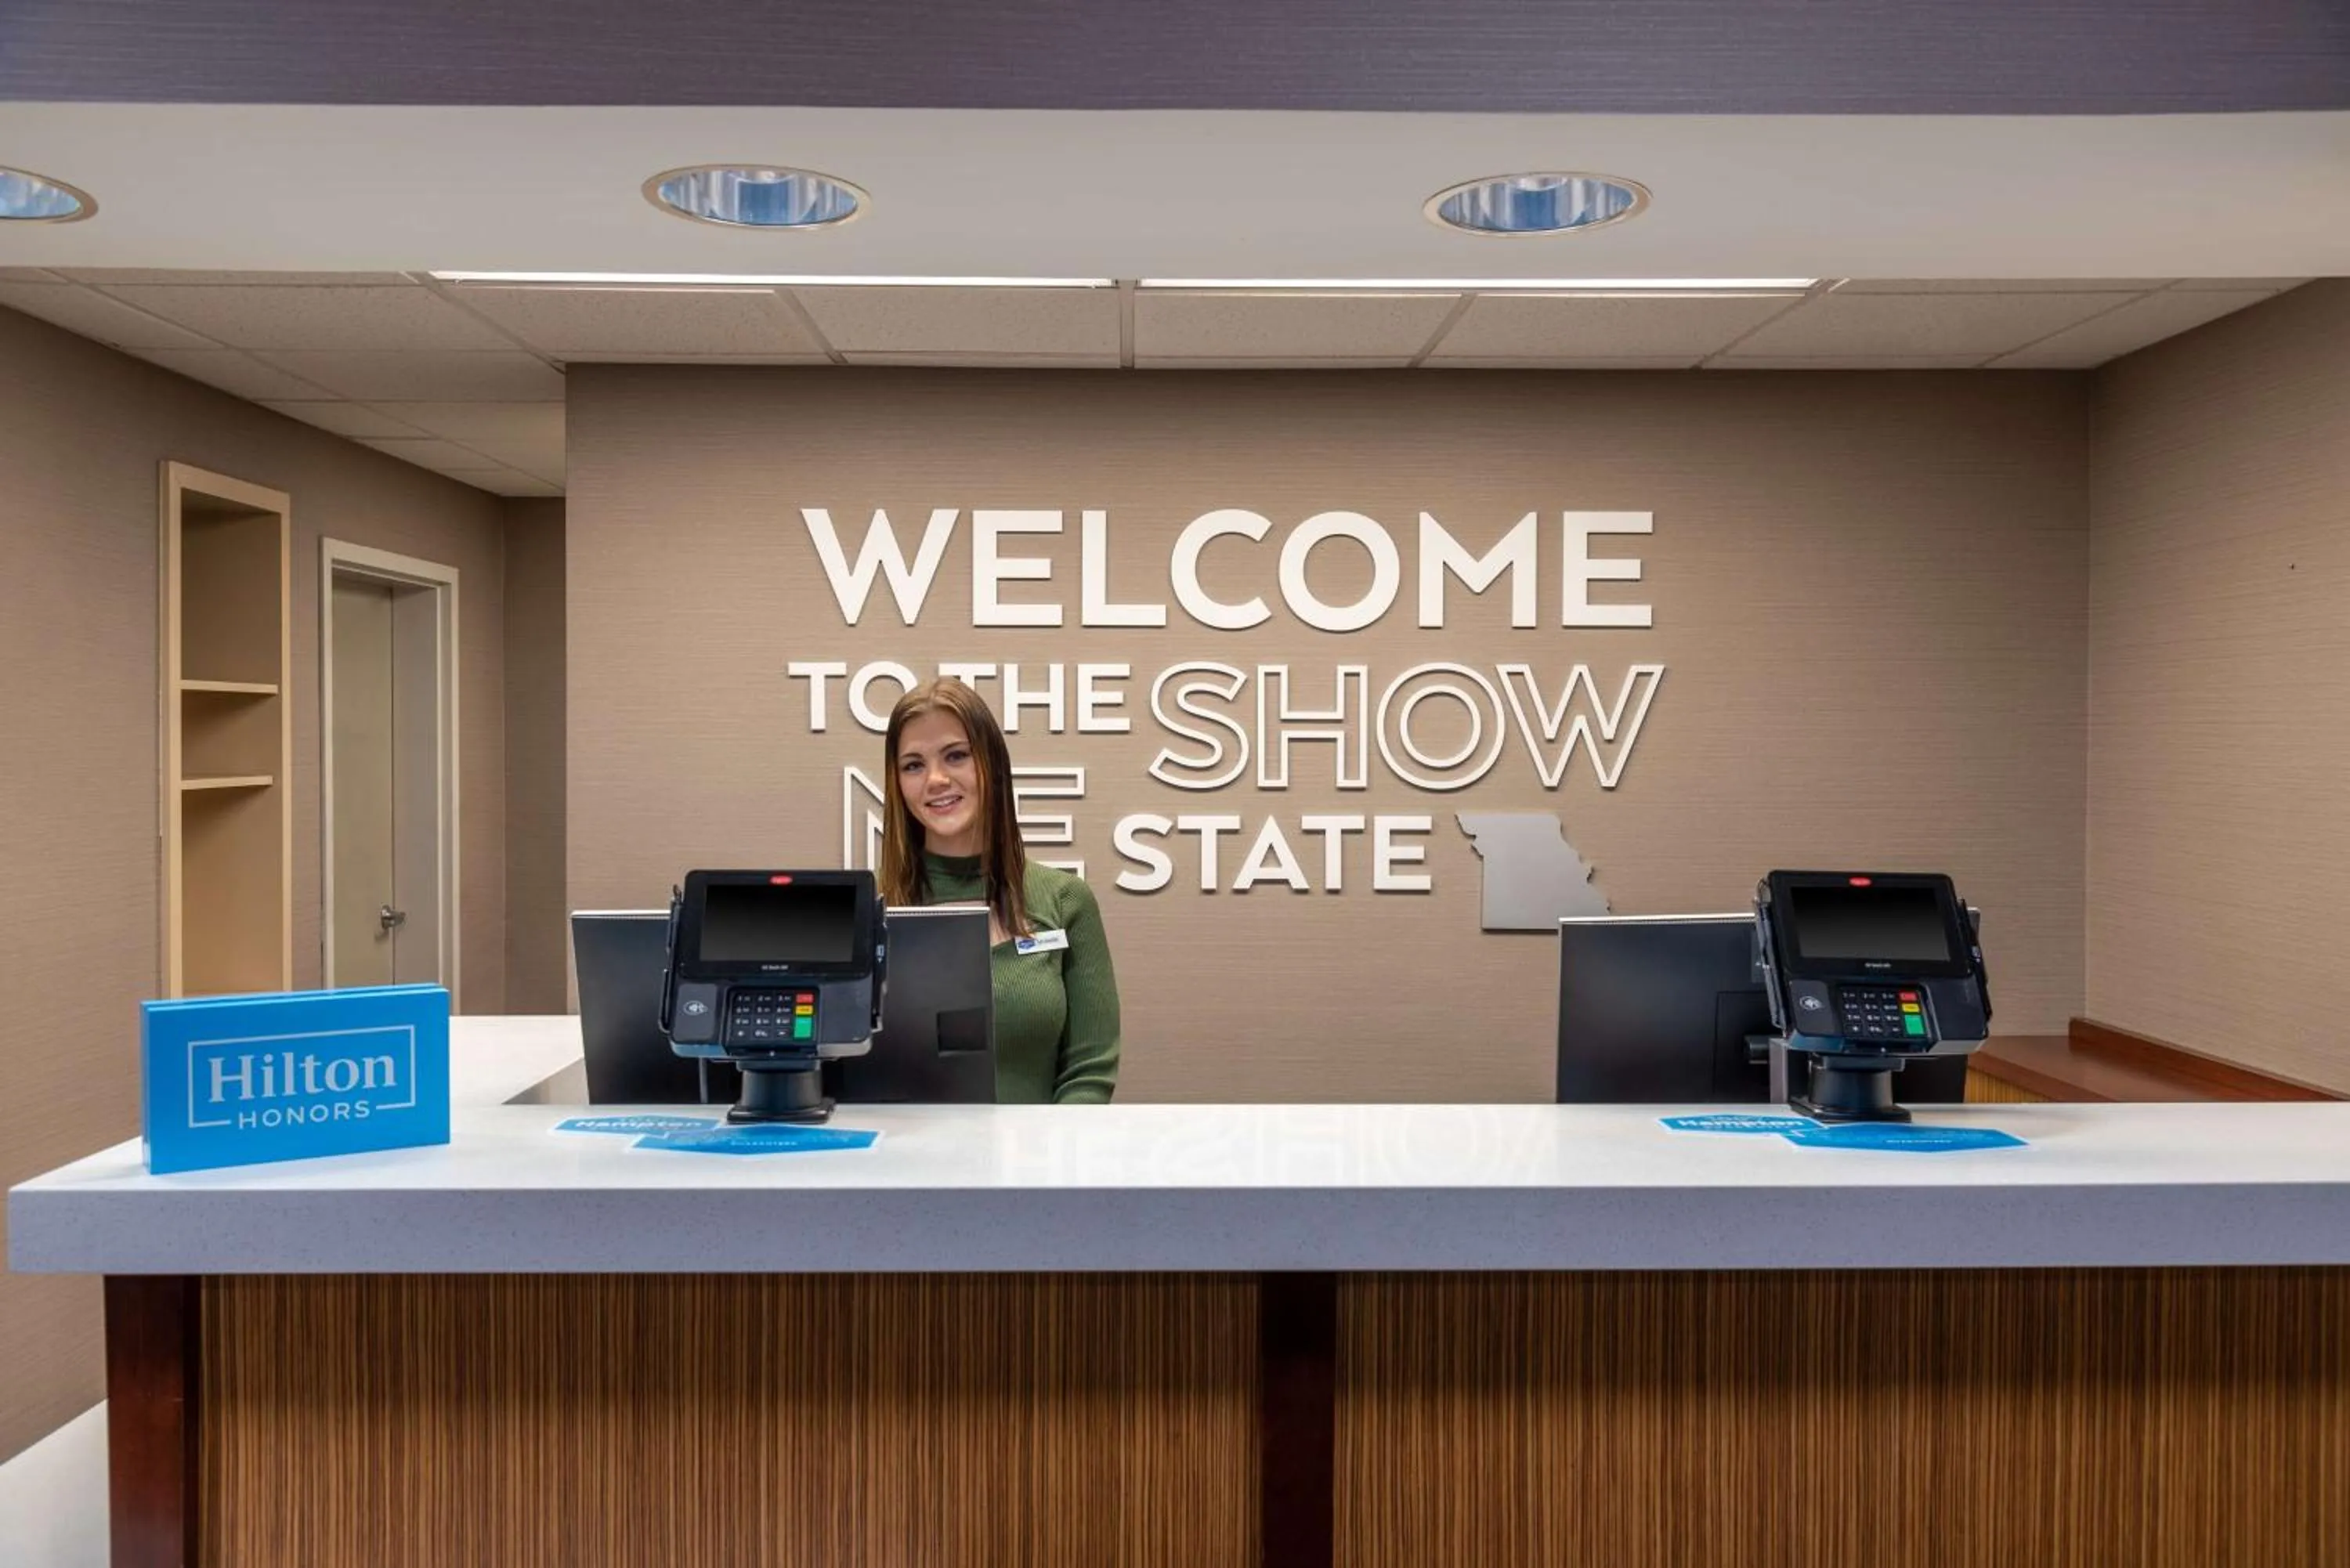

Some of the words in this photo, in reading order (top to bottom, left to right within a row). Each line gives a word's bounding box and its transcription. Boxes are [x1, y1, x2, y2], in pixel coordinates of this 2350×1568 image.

[801, 508, 1654, 630] WELCOME
[787, 661, 920, 734] TO
[1148, 660, 1665, 790] SHOW
[1112, 813, 1433, 892] STATE
[207, 1051, 397, 1104] Hilton
[238, 1100, 371, 1129] HONORS
